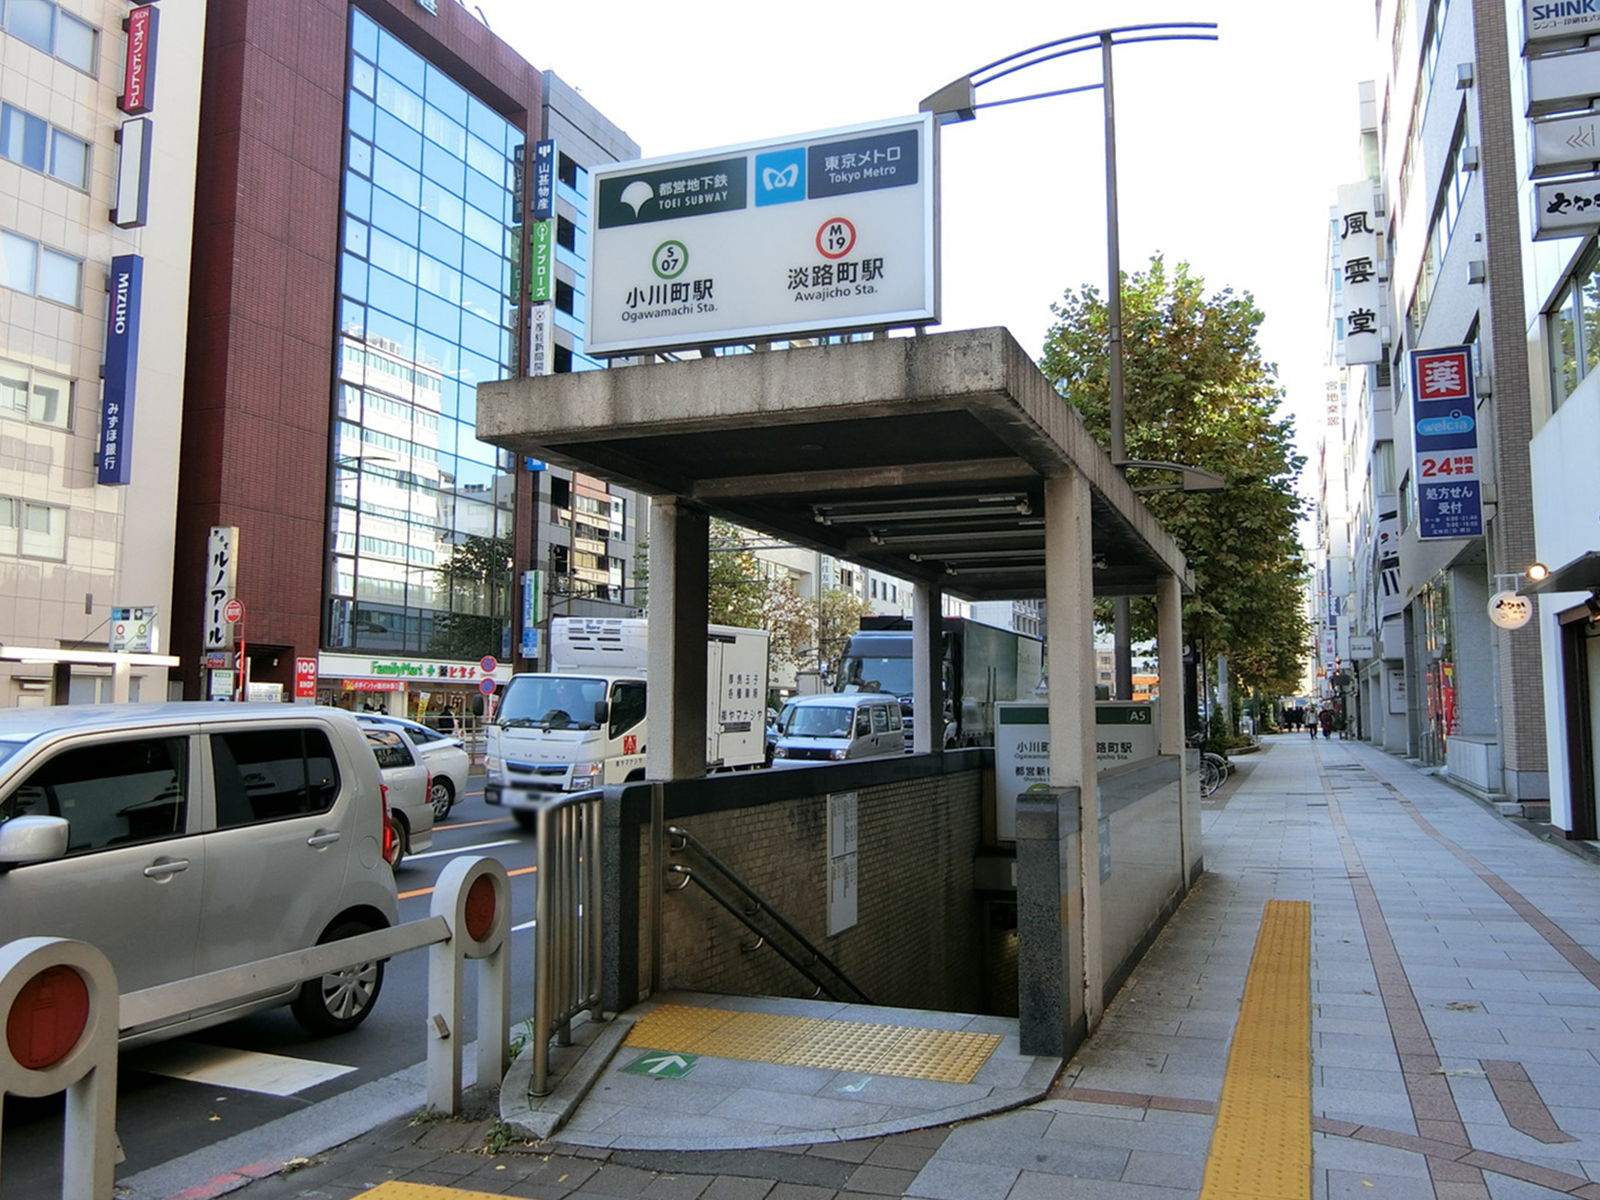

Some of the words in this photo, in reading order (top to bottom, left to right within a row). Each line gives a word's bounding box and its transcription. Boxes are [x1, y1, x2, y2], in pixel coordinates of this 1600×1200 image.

[1532, 0, 1600, 20] SHINK
[824, 146, 901, 171] 東京メトロ
[658, 173, 729, 196] 都営地下鉄
[829, 171, 860, 184] Tokyo
[863, 166, 896, 179] Metro
[537, 162, 550, 210] 山甚物産
[658, 198, 681, 210] TOEI
[685, 191, 728, 207] SUBWAY
[829, 224, 843, 237] M
[667, 247, 675, 258] S
[828, 237, 846, 250] 19
[661, 259, 679, 272] 07
[787, 257, 884, 290] 淡路町駅
[1341, 210, 1377, 338] 風雲堂
[626, 279, 714, 308] 小川町駅
[795, 286, 851, 302] Awajicho
[855, 284, 878, 295] Sta.
[115, 272, 129, 335] MIZUHO
[621, 304, 693, 323] Ogawamachi
[696, 301, 718, 313] Sta.
[1425, 360, 1461, 394] 薬
[1423, 420, 1468, 432] welcia
[104, 402, 119, 470] みずほ銀行
[1422, 457, 1453, 477] 24
[1426, 486, 1474, 500] 処方せん
[1438, 501, 1463, 514] 受付
[209, 551, 229, 645] ルノアール
[297, 661, 315, 674] 100
[370, 660, 423, 678] FamilyMart
[1129, 711, 1146, 721] A5
